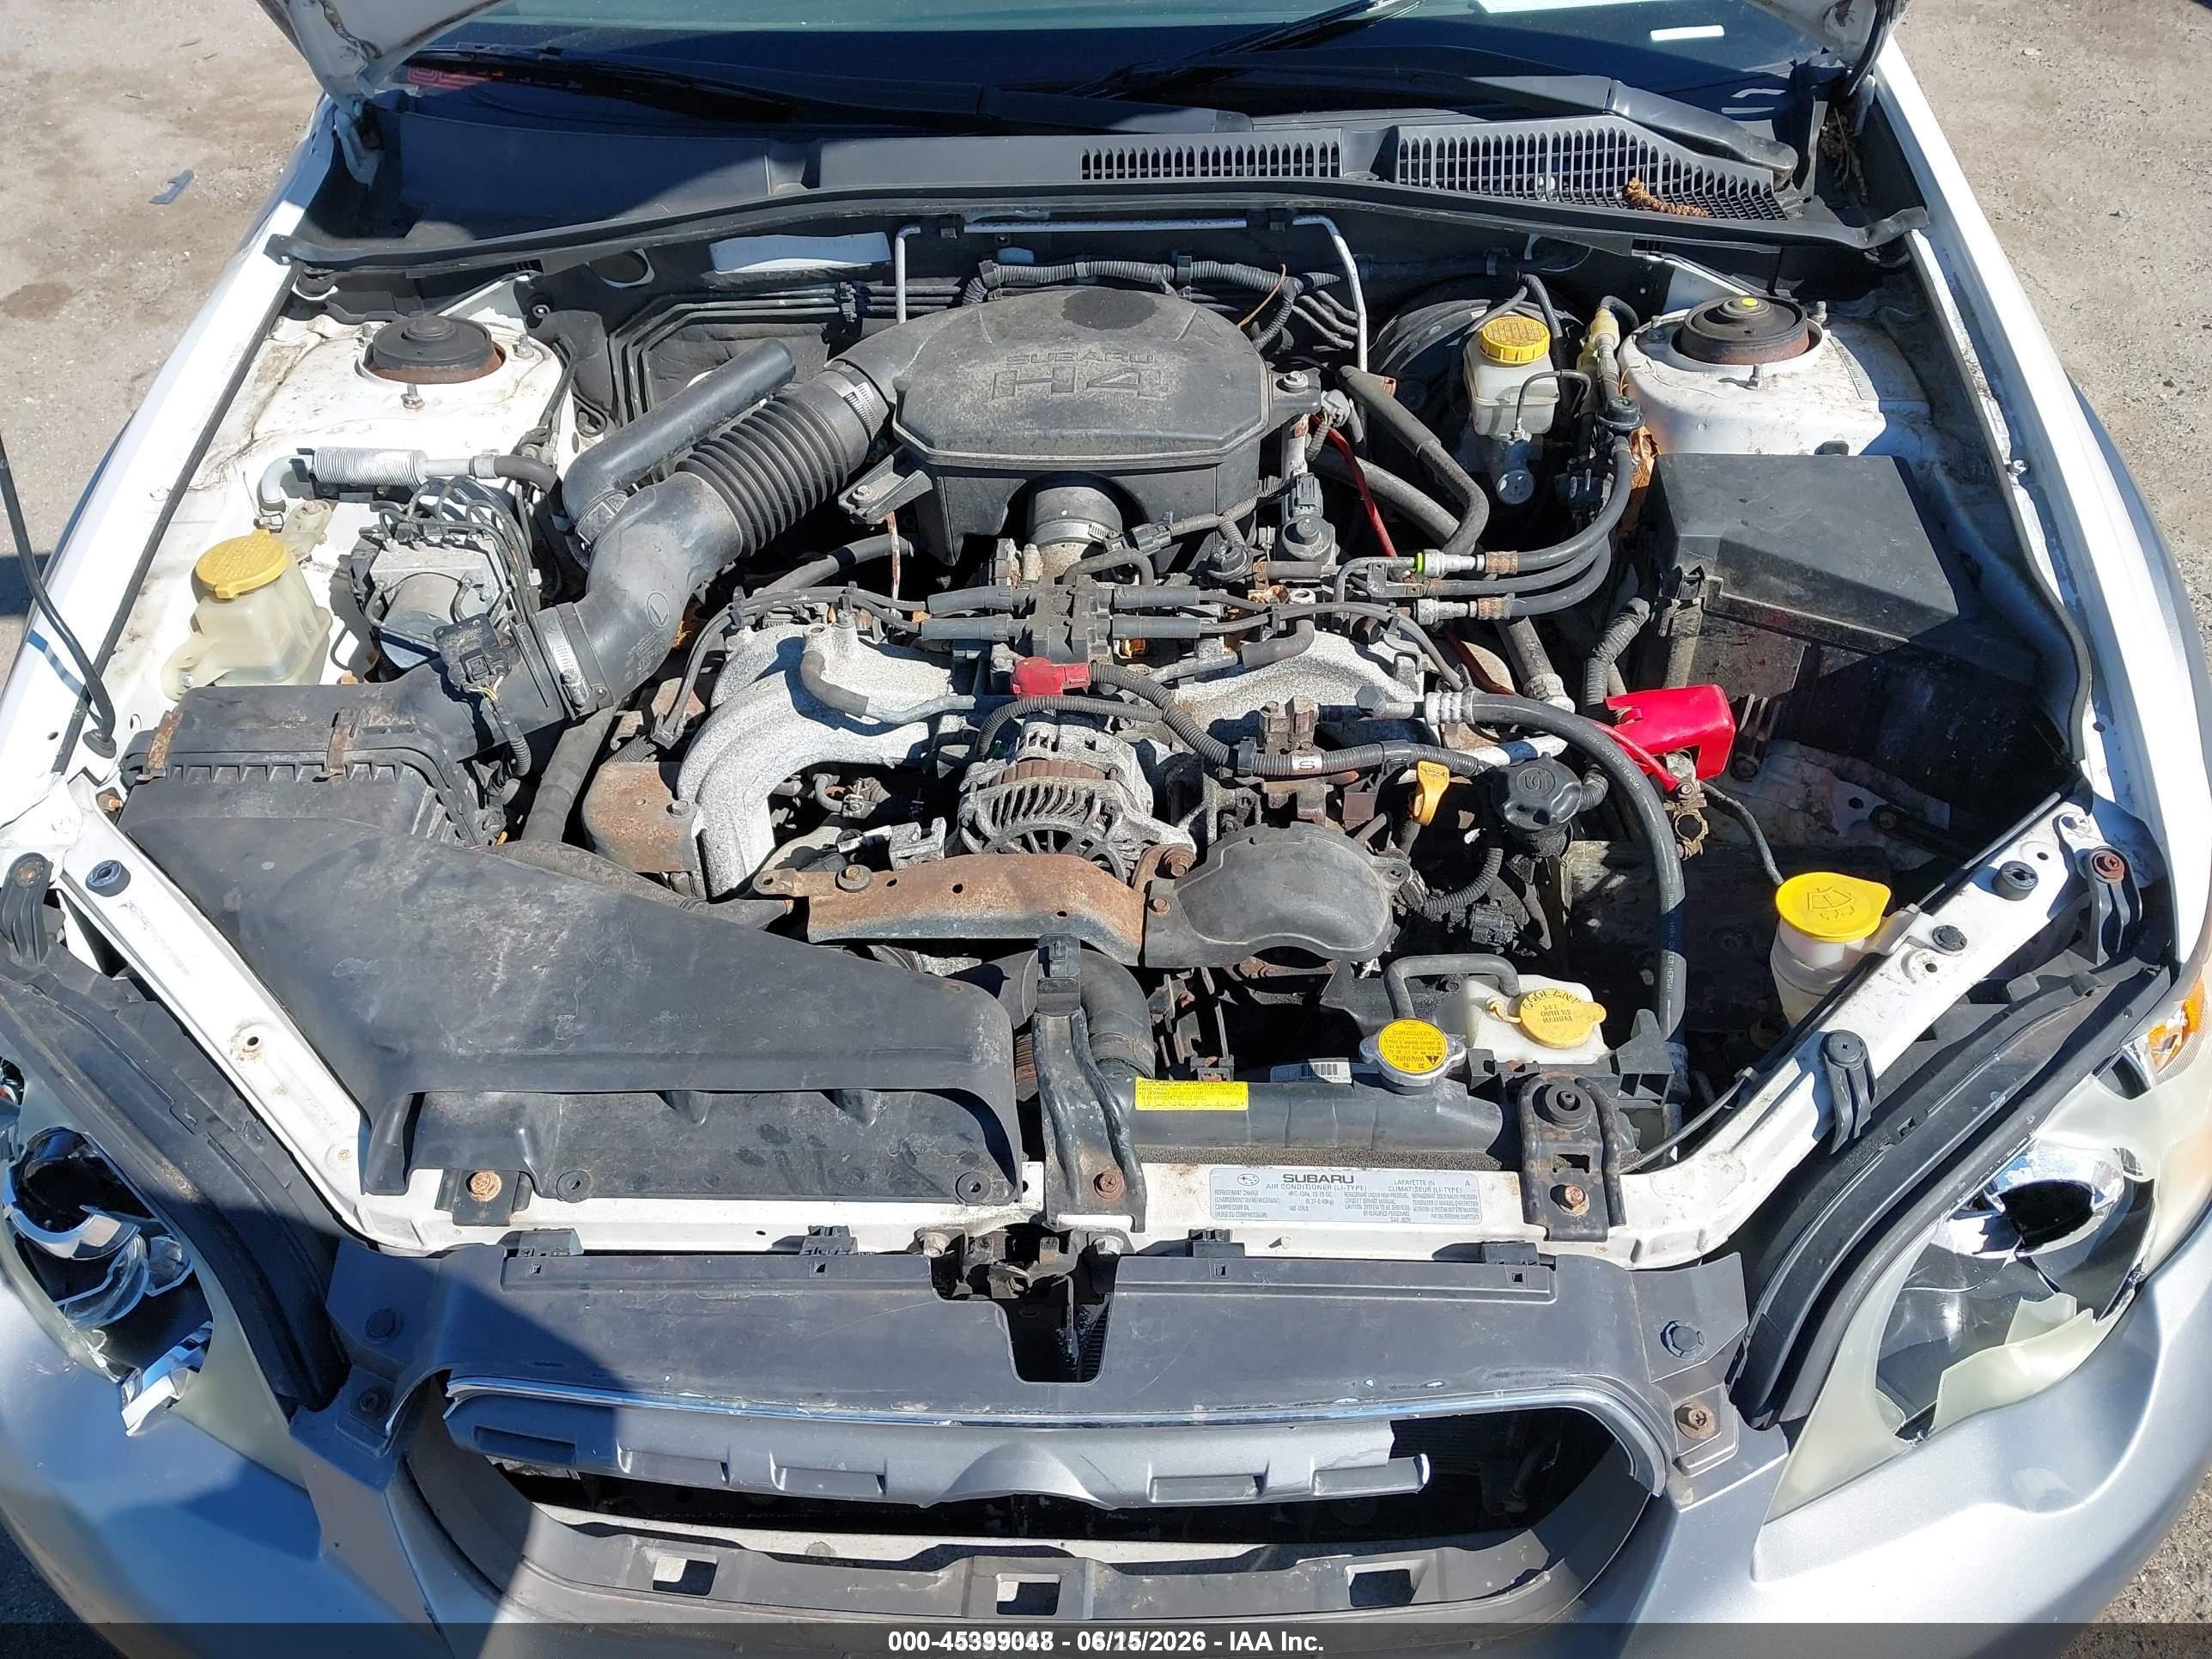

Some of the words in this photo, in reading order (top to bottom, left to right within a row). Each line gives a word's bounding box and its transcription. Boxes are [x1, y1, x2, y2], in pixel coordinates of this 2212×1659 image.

[1006, 352, 1155, 368] SUBARU
[991, 366, 1164, 402] H4
[1299, 760, 1316, 770] S
[1601, 746, 1623, 767] OUTER
[1522, 989, 1581, 1010] COOLANT
[1283, 1174, 1354, 1184] SUBARU
